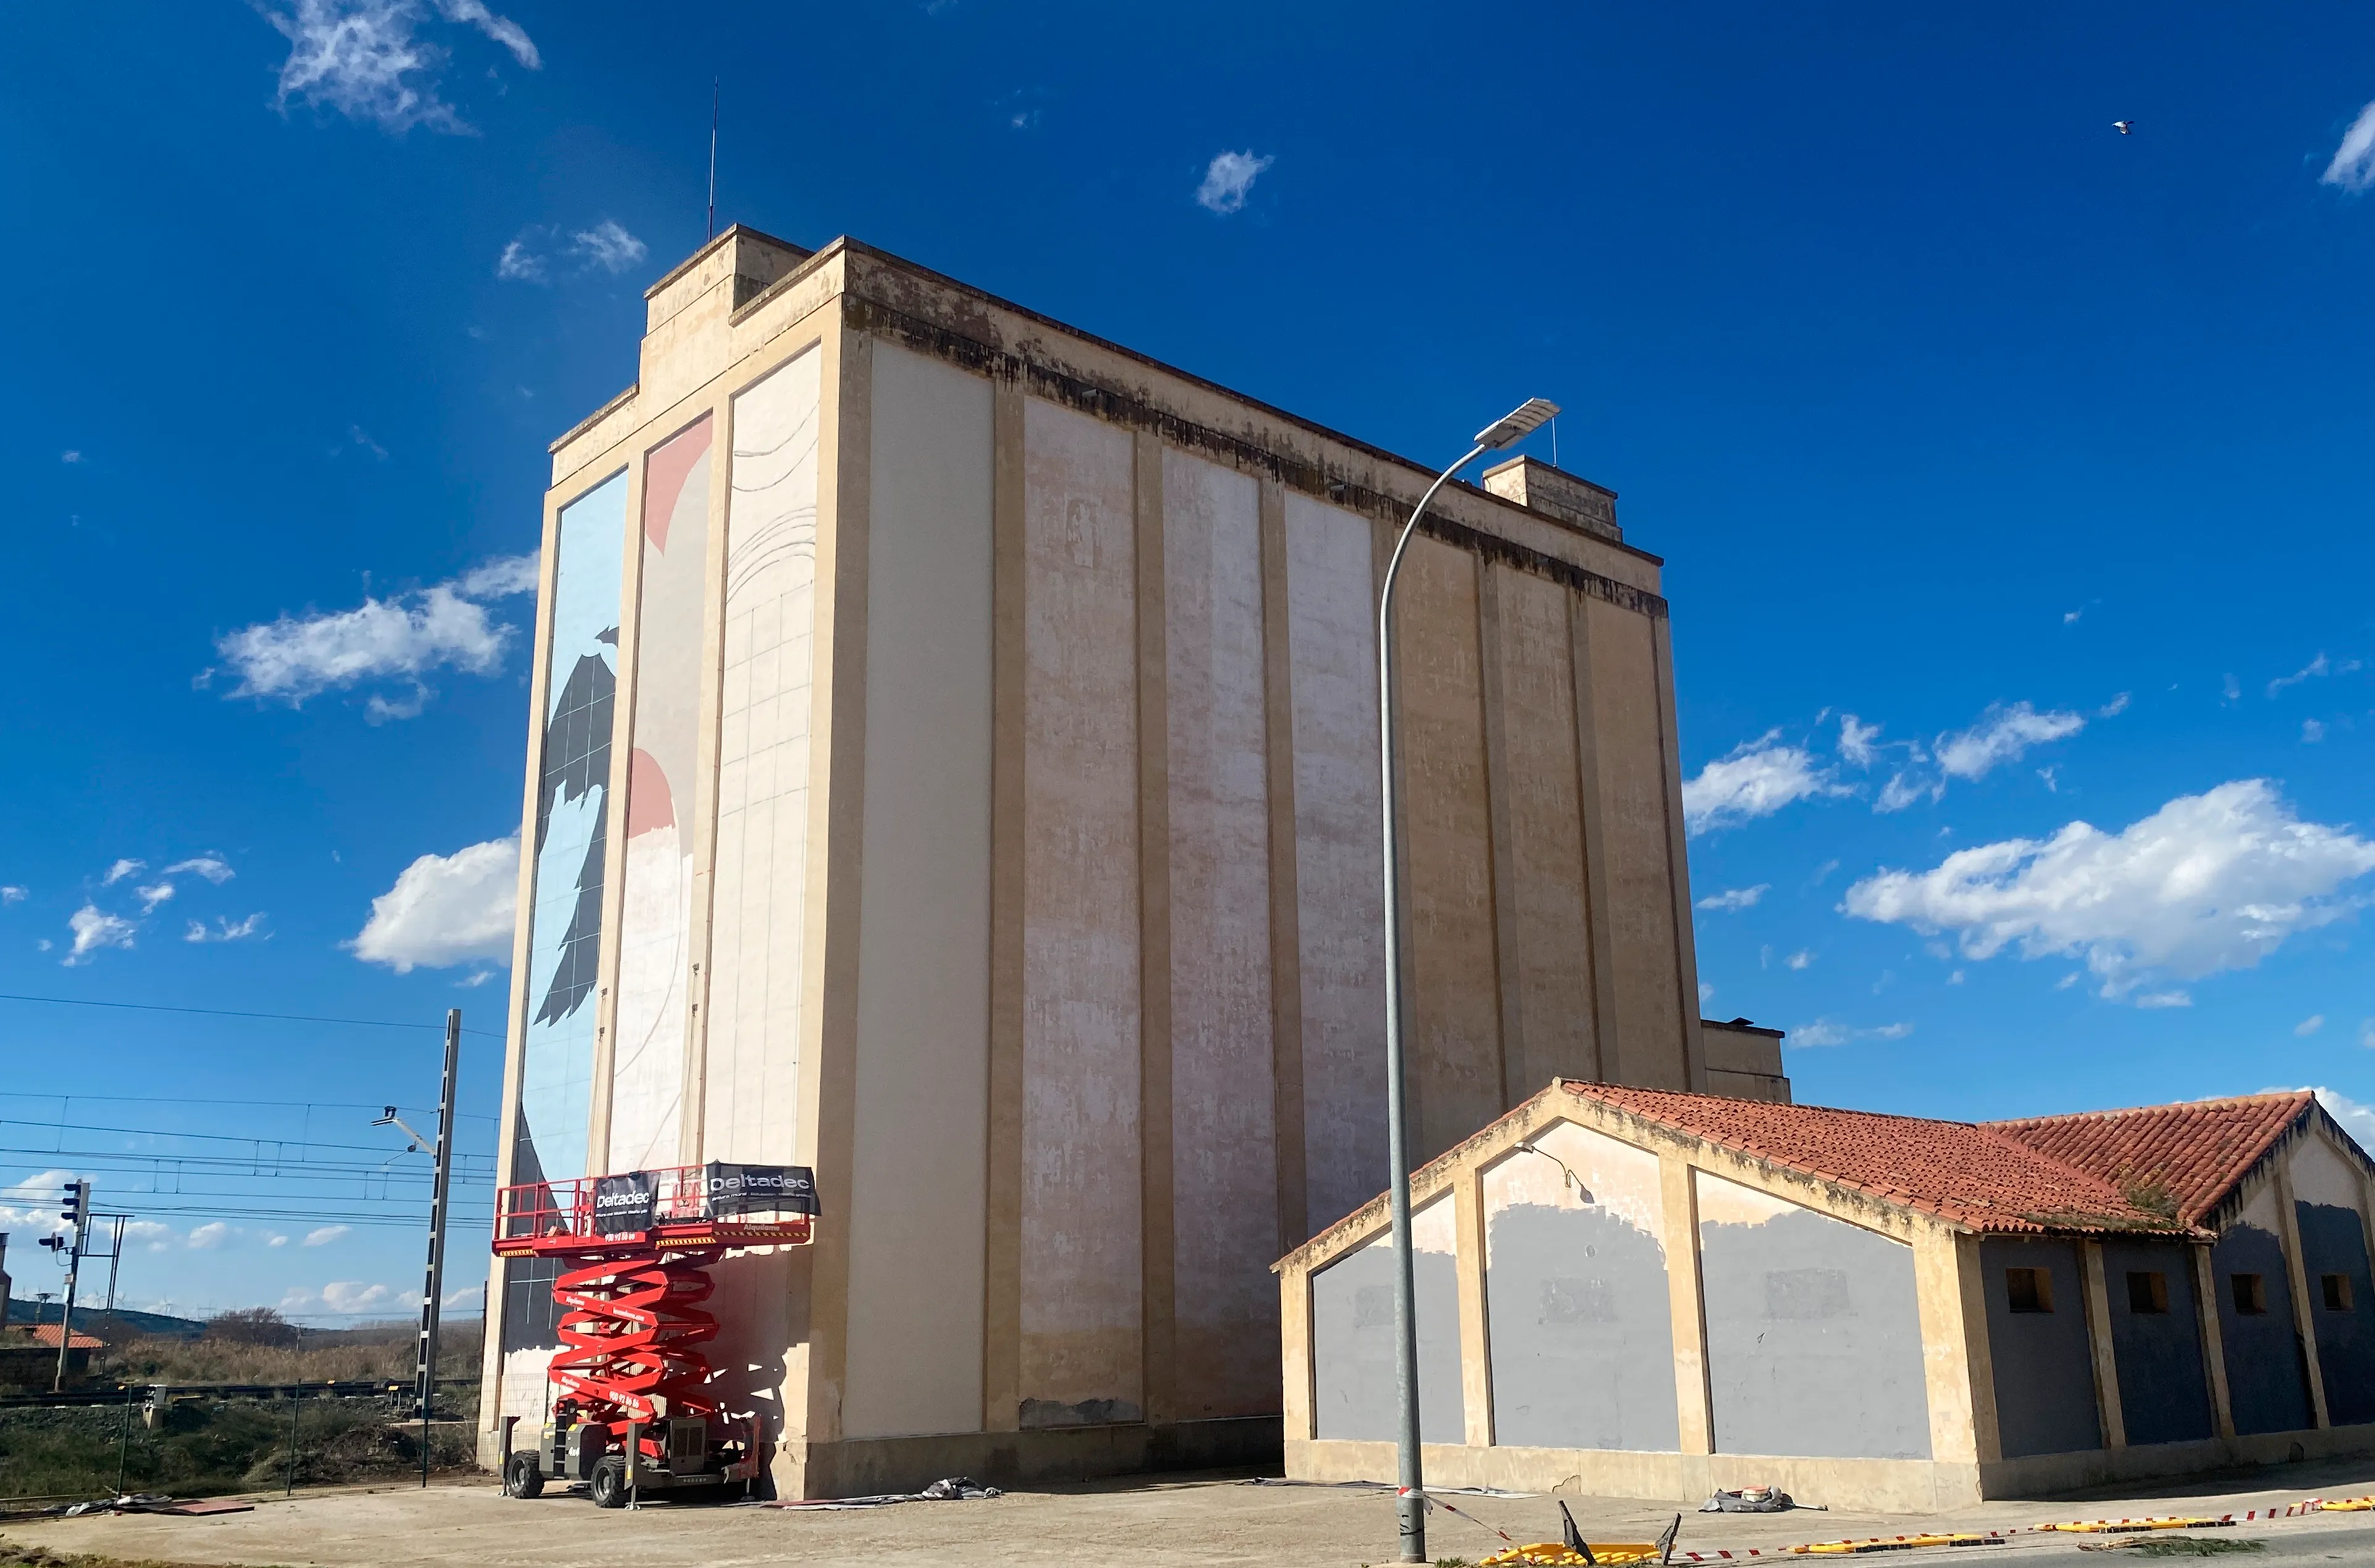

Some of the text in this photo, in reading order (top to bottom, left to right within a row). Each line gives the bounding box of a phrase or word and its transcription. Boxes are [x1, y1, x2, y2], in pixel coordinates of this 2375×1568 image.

[710, 1174, 810, 1192] Deltadec
[597, 1190, 649, 1209] Deltadec
[744, 1223, 780, 1232] Alquilame
[568, 1446, 580, 1457] 4x4
